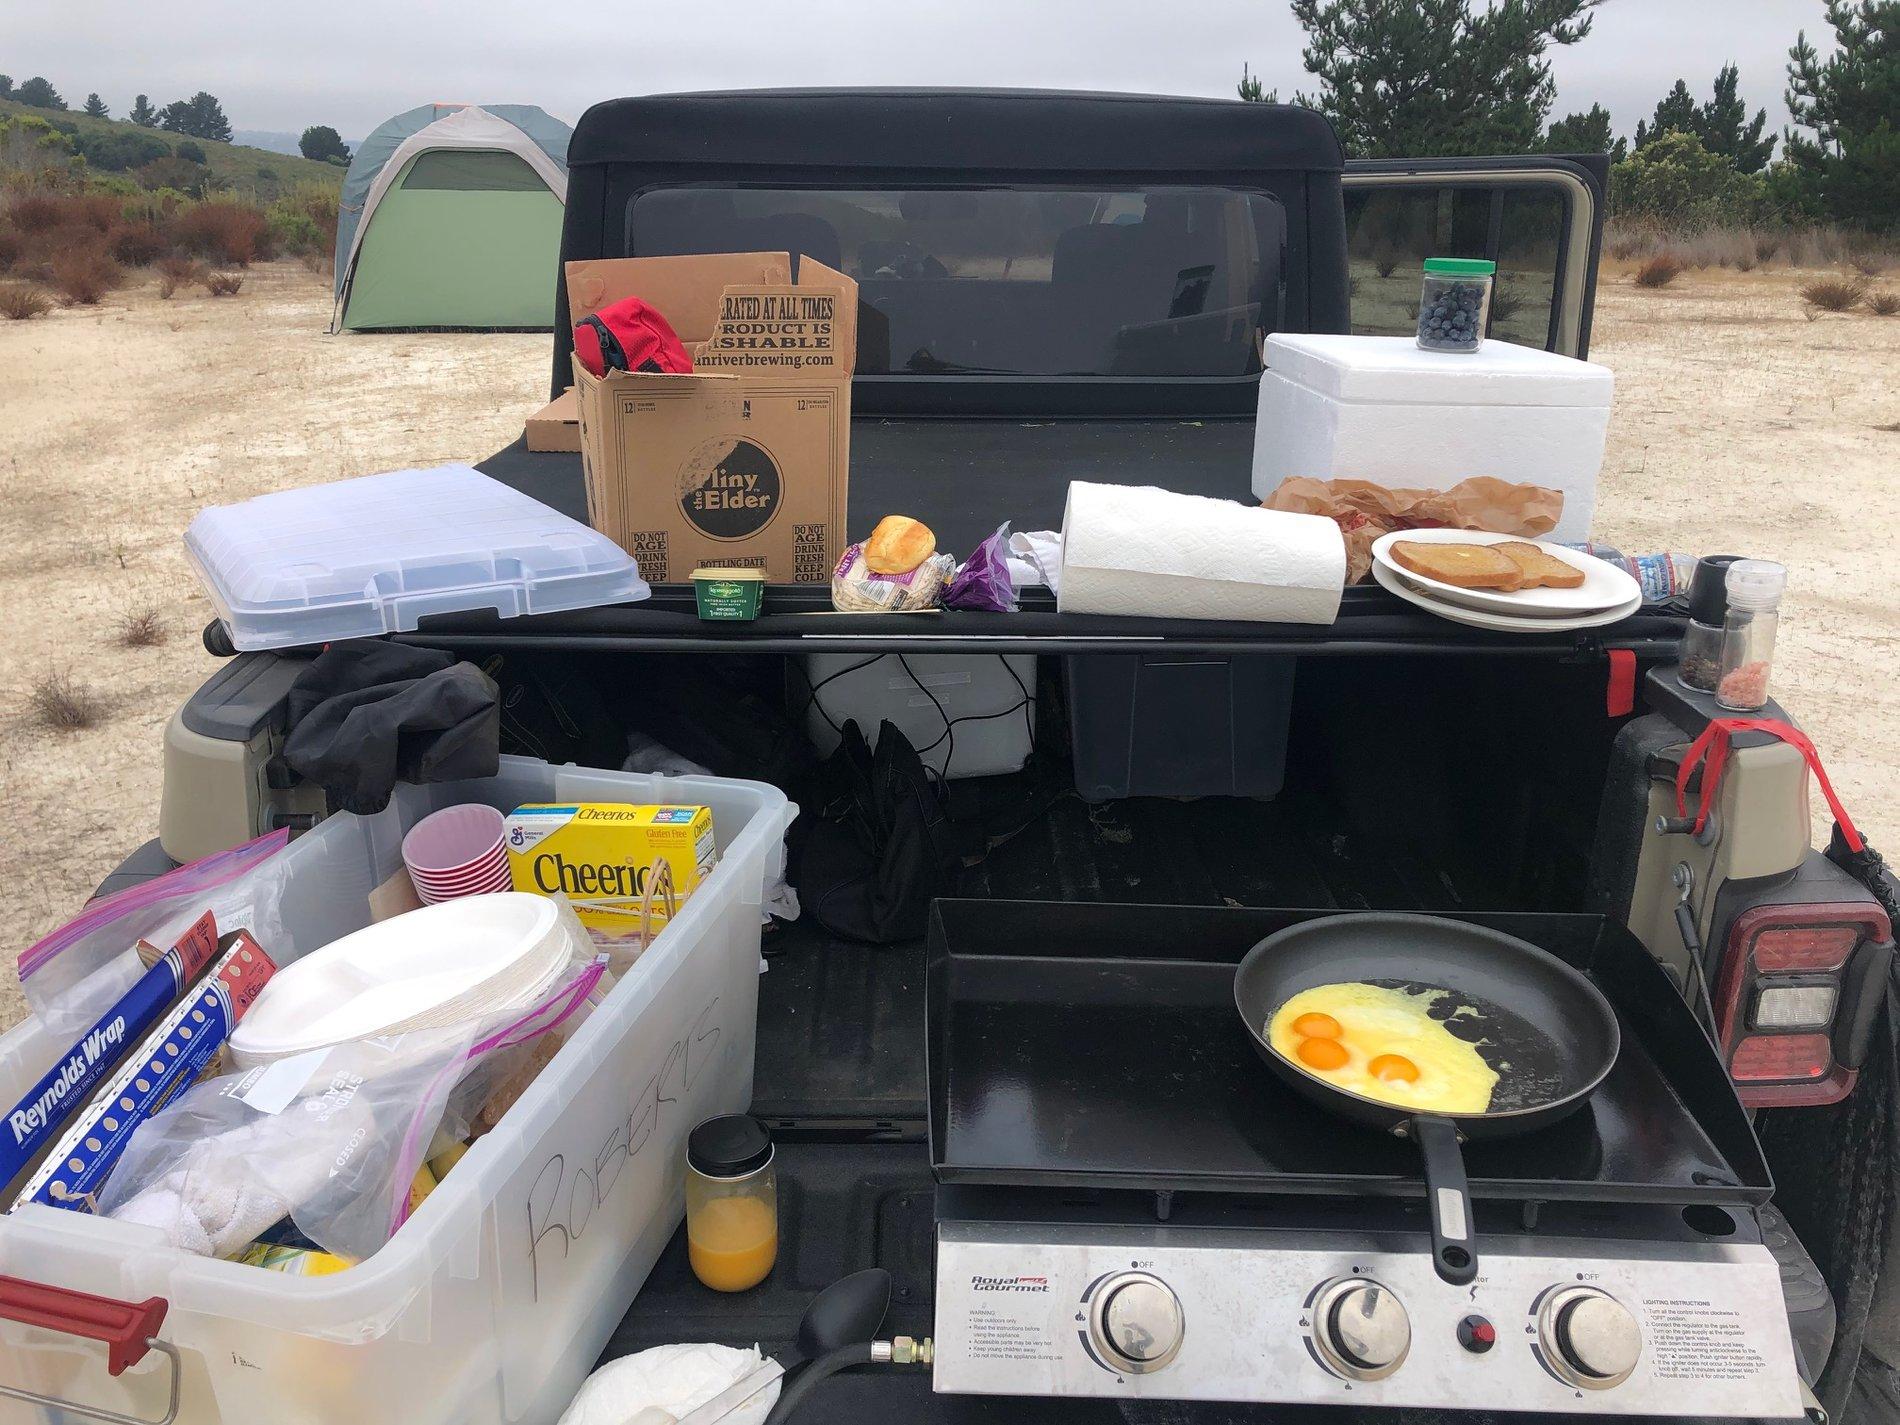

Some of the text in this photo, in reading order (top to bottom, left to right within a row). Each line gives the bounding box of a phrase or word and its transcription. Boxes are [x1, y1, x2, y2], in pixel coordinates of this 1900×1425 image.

[763, 298, 776, 320] AT
[779, 298, 799, 320] ALL
[801, 298, 833, 321] TIMES
[718, 323, 831, 335] RODUCT IS
[624, 402, 634, 414] 12
[797, 400, 806, 411] 12
[711, 468, 759, 492] liny
[693, 489, 771, 511] the Elder
[794, 525, 825, 535] DO NOT
[634, 532, 666, 542] DO NOT
[795, 534, 825, 543] AGE
[635, 541, 667, 551] AGE
[794, 545, 825, 554] DRINK
[635, 552, 668, 563] DRINK
[795, 554, 824, 563] FRESH
[744, 558, 765, 568] DATE
[795, 564, 824, 573] KEEP
[795, 573, 825, 582] COLD
[577, 808, 637, 821] Cheerios
[646, 828, 688, 838] Gluten Free
[533, 853, 669, 898] Cheerio
[8, 1058, 87, 1146] Reynolds
[80, 1015, 126, 1065] Wrap
[61, 1087, 82, 1110] TRUSTED
[336, 1127, 367, 1167] CLOSED
[971, 1276, 1020, 1285] Royal
[1585, 1273, 1600, 1281] OFF
[973, 1283, 1050, 1292] Gourmet
